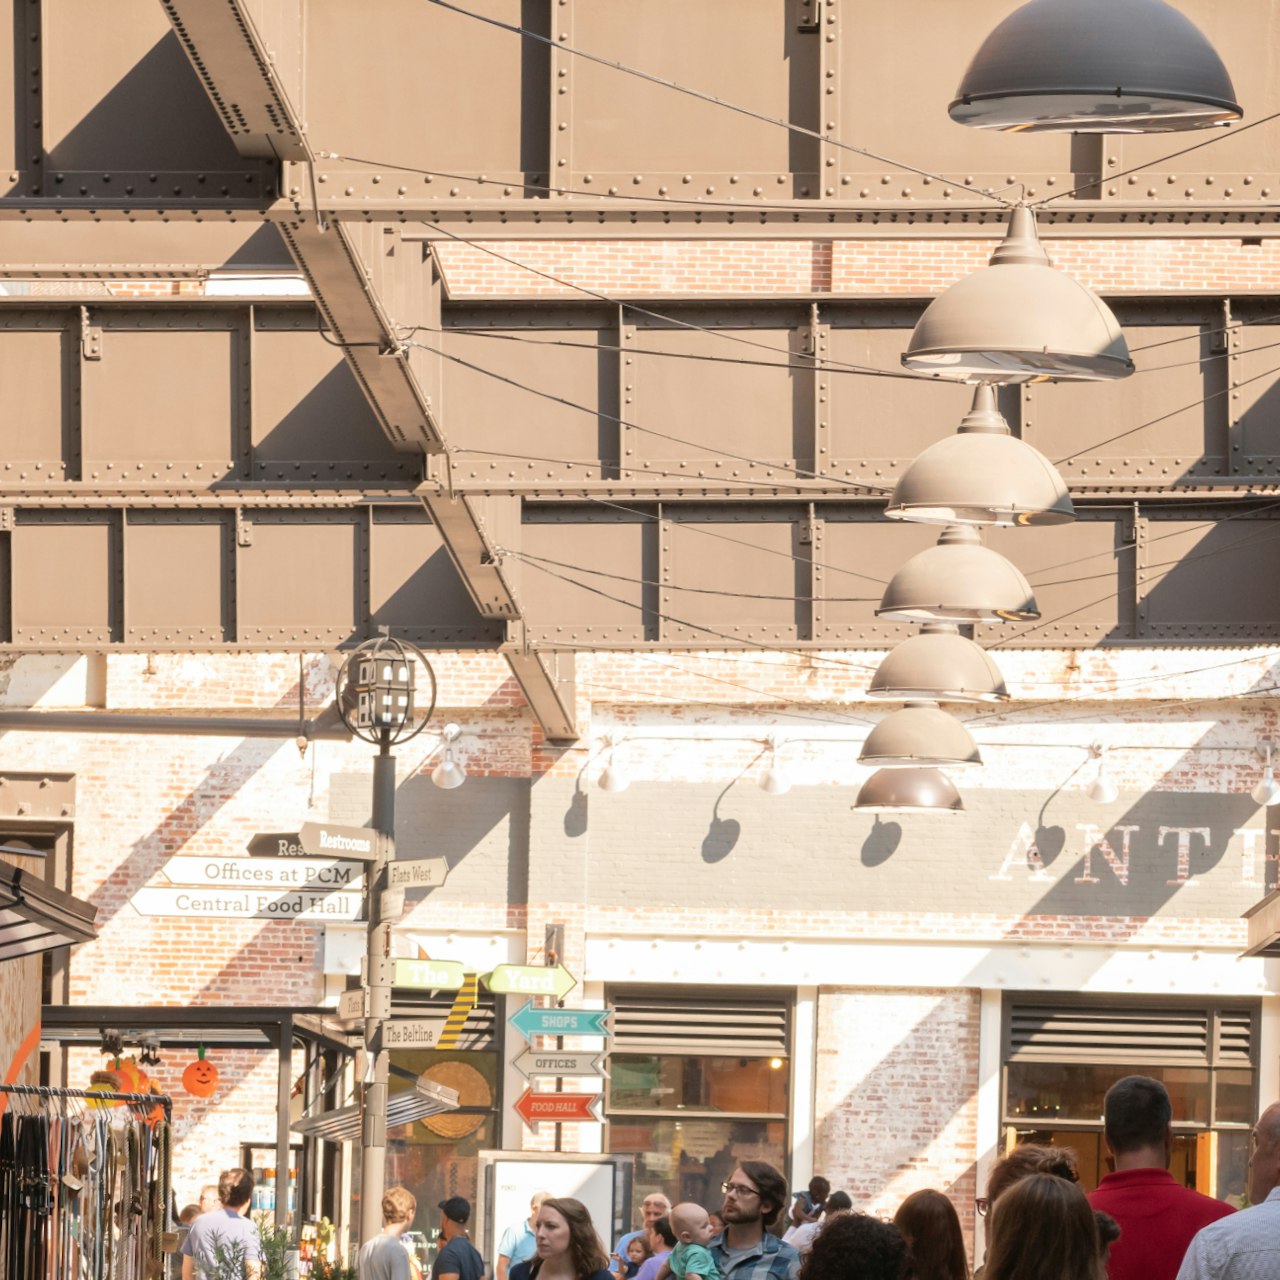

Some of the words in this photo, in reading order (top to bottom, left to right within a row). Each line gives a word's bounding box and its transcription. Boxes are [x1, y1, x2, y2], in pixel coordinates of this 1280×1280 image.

[320, 830, 371, 852] Restrooms
[205, 863, 273, 881] Offices
[279, 869, 299, 882] at
[305, 867, 351, 883] PCM
[392, 866, 410, 883] Flats
[412, 865, 431, 881] West
[176, 895, 249, 911] Central
[257, 896, 303, 913] Food
[310, 897, 350, 914] Hall
[408, 963, 449, 985] The
[504, 969, 555, 990] Yard
[541, 1015, 577, 1029] SHOPS
[386, 1026, 401, 1043] The
[403, 1026, 433, 1043] Beltline
[535, 1059, 577, 1069] OFFICES
[531, 1102, 555, 1112] FOOD
[556, 1102, 578, 1112] HALL
